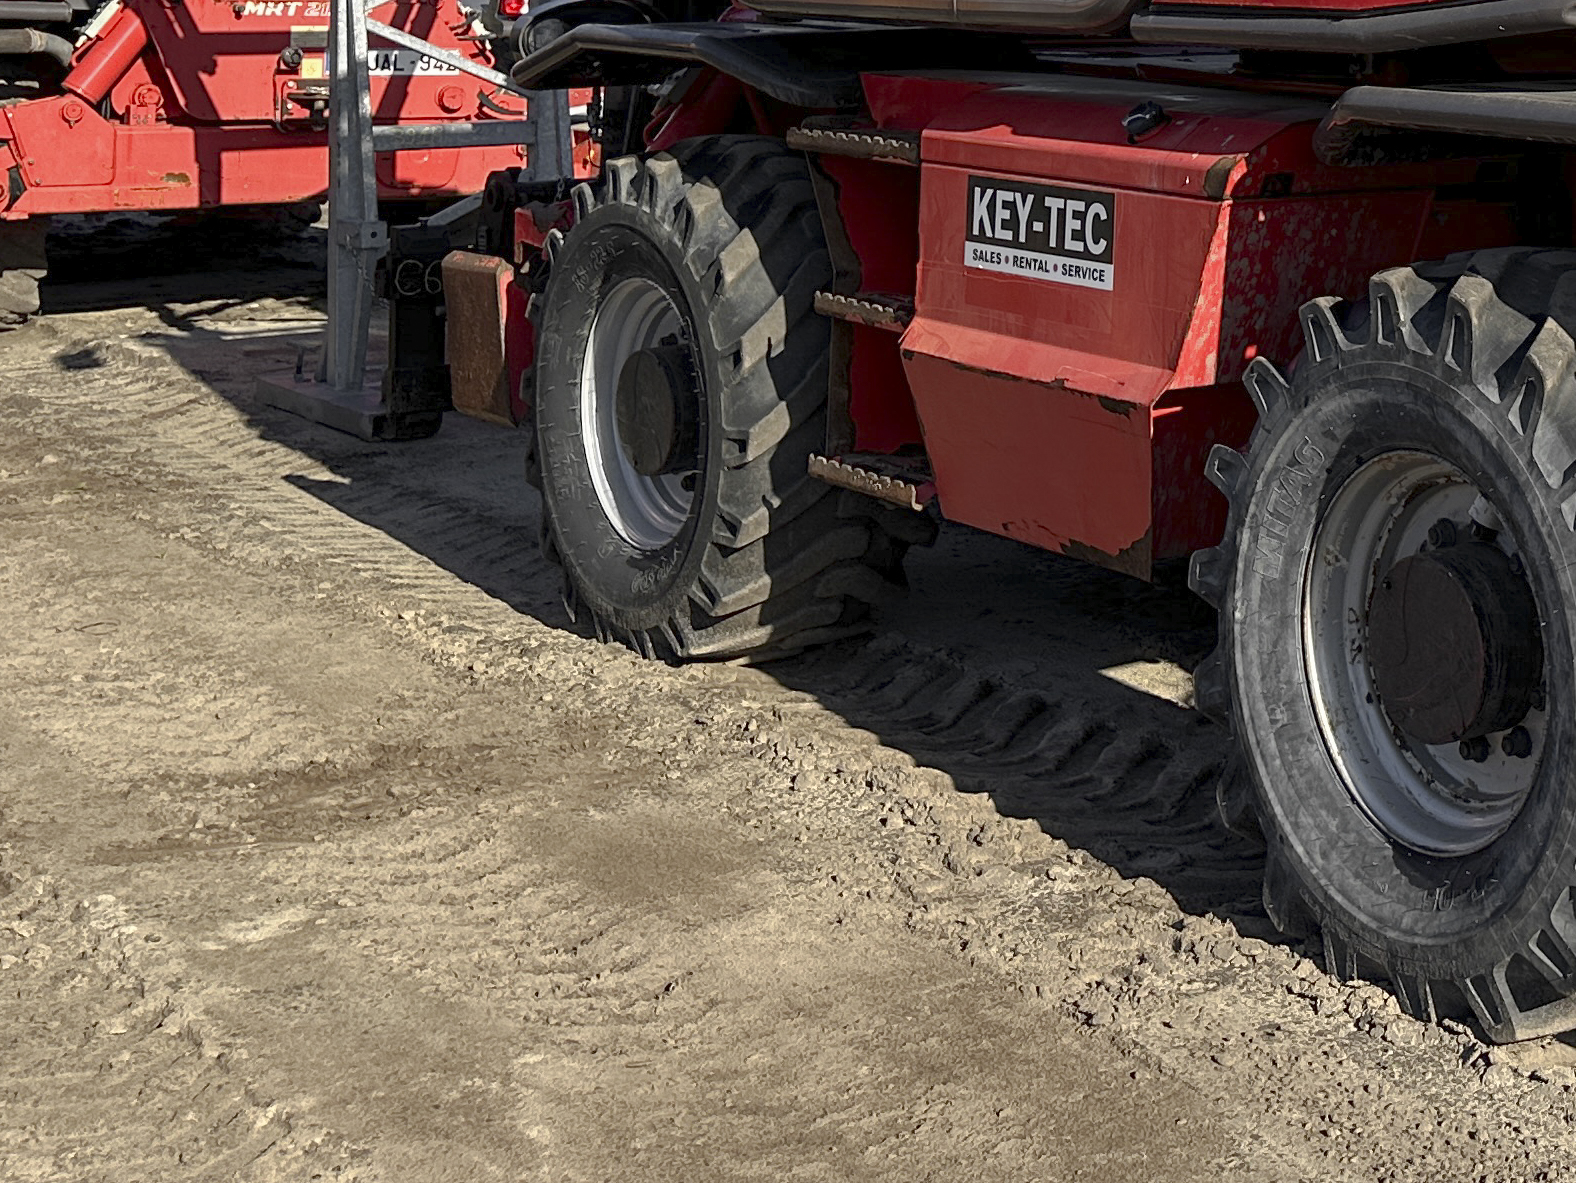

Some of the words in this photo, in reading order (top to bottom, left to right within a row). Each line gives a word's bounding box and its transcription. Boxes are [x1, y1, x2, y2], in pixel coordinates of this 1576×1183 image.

[972, 186, 1108, 256] KEY-TEC
[972, 248, 1002, 265] SALES
[1012, 255, 1050, 273] RENTAL
[1061, 263, 1106, 283] SERVICE
[1252, 435, 1325, 579] MITAS
